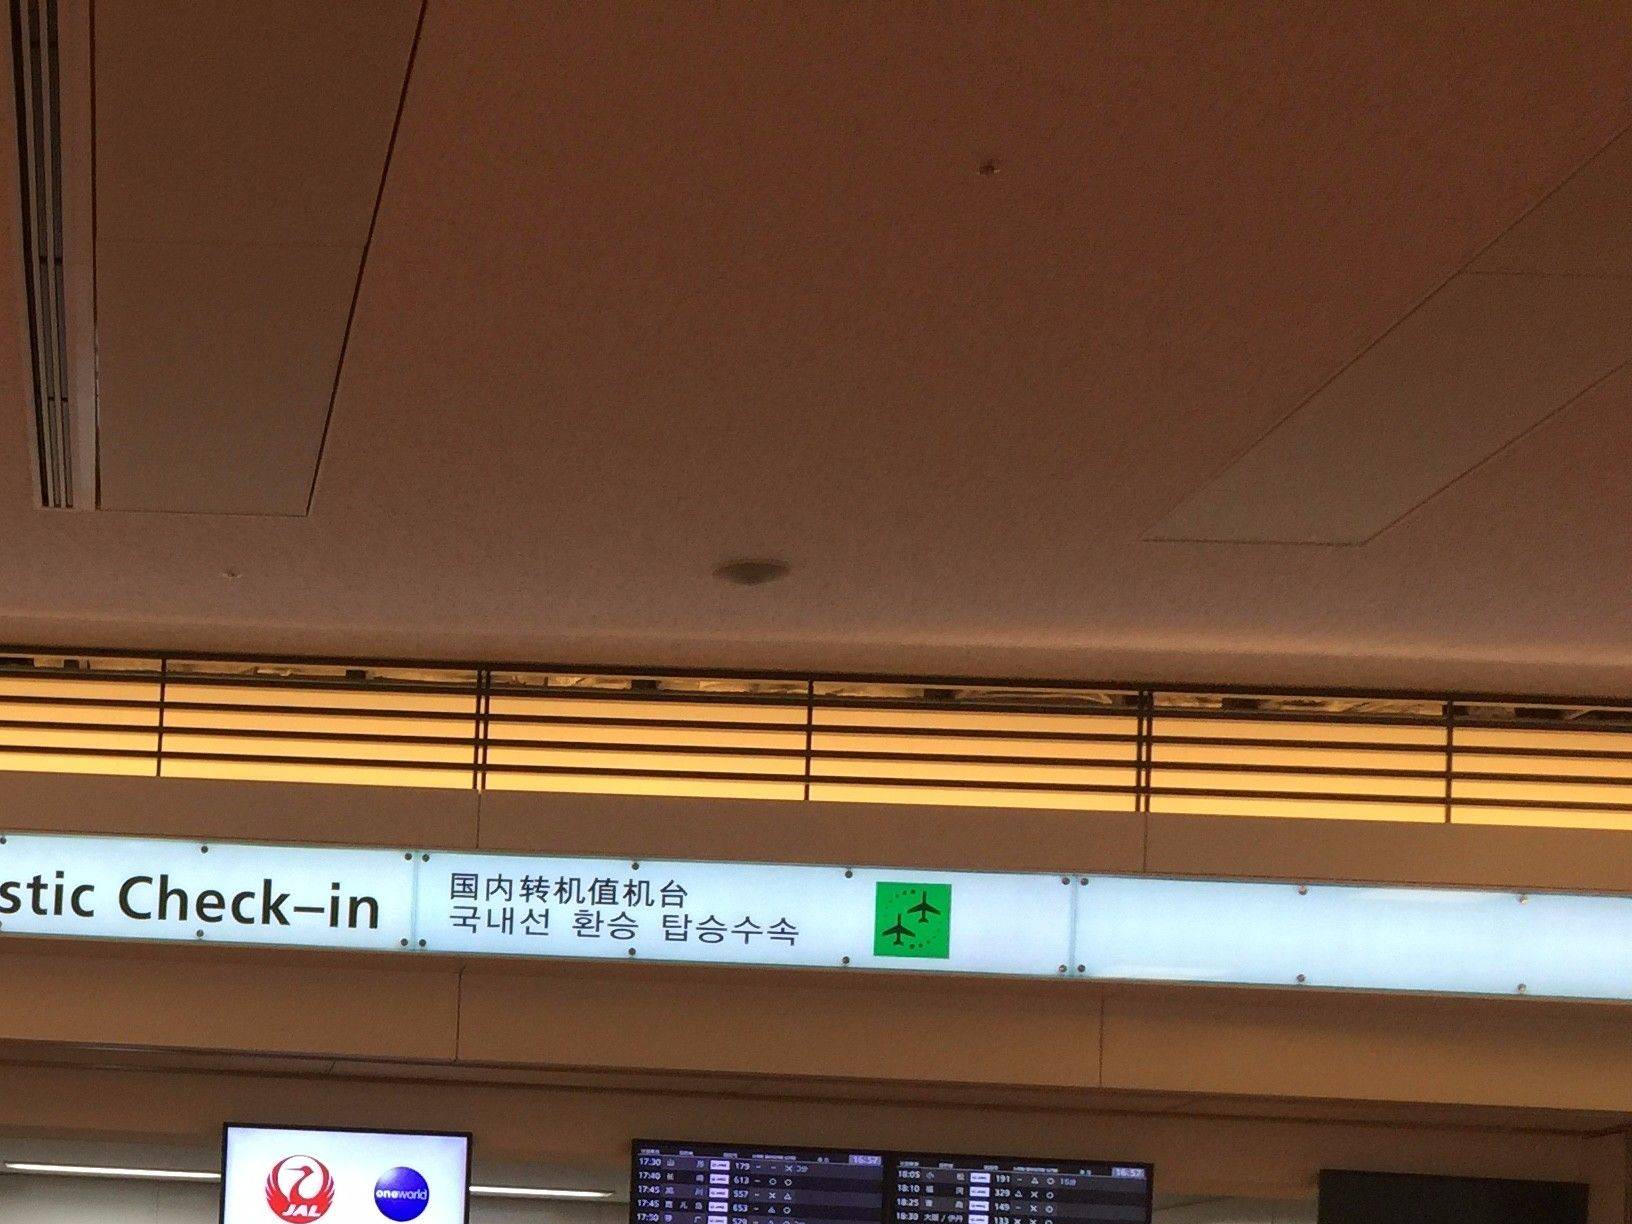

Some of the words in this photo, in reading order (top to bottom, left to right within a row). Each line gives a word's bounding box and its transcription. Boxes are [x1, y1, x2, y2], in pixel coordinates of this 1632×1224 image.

[118, 874, 380, 929] Check-in
[449, 872, 689, 909] 国内转机值机台
[448, 905, 551, 937] 국내선
[571, 908, 640, 941] 환승
[661, 913, 800, 946] 탑승수속
[281, 1204, 321, 1217] JAL
[375, 1189, 428, 1200] oneworld
